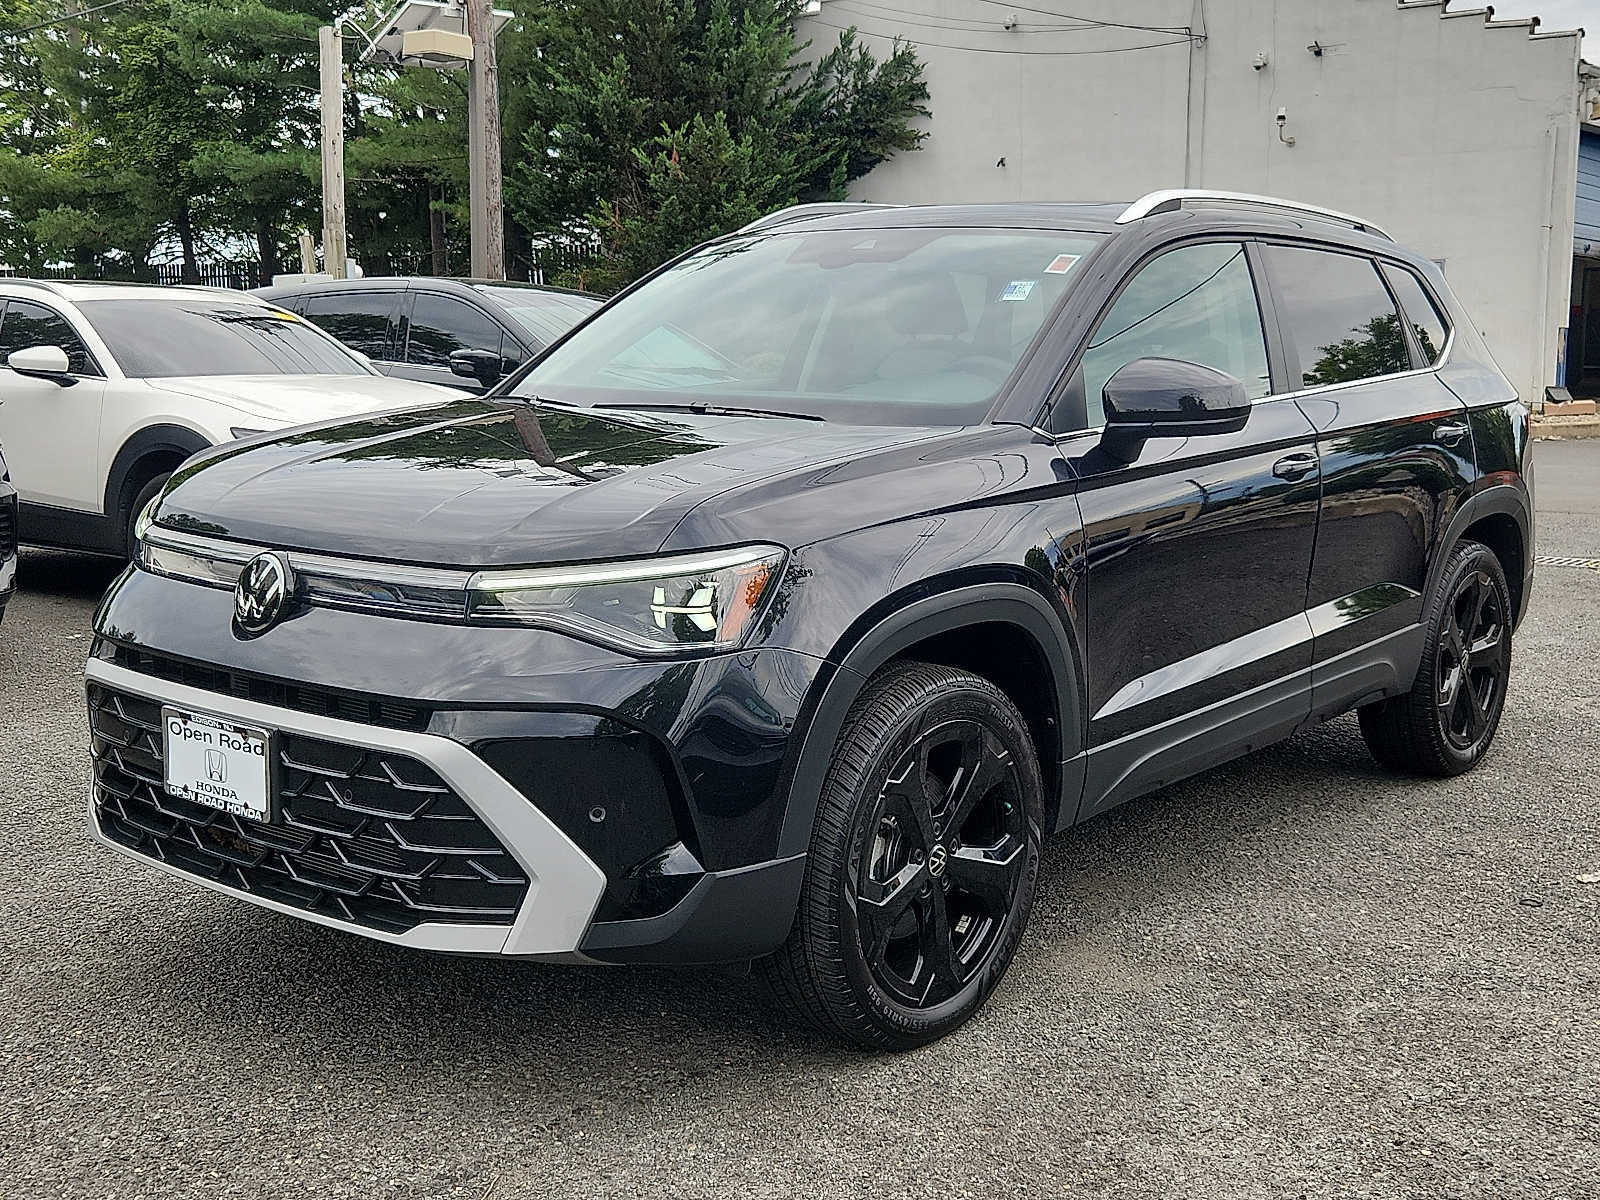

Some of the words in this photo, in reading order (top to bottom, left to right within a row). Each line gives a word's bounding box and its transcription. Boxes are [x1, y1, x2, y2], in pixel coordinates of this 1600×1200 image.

[169, 721, 213, 744] Open
[219, 733, 265, 756] Road
[169, 785, 196, 801] OPEN
[197, 794, 225, 810] ROAD
[226, 803, 262, 821] HONDA
[196, 780, 240, 801] HONDA
